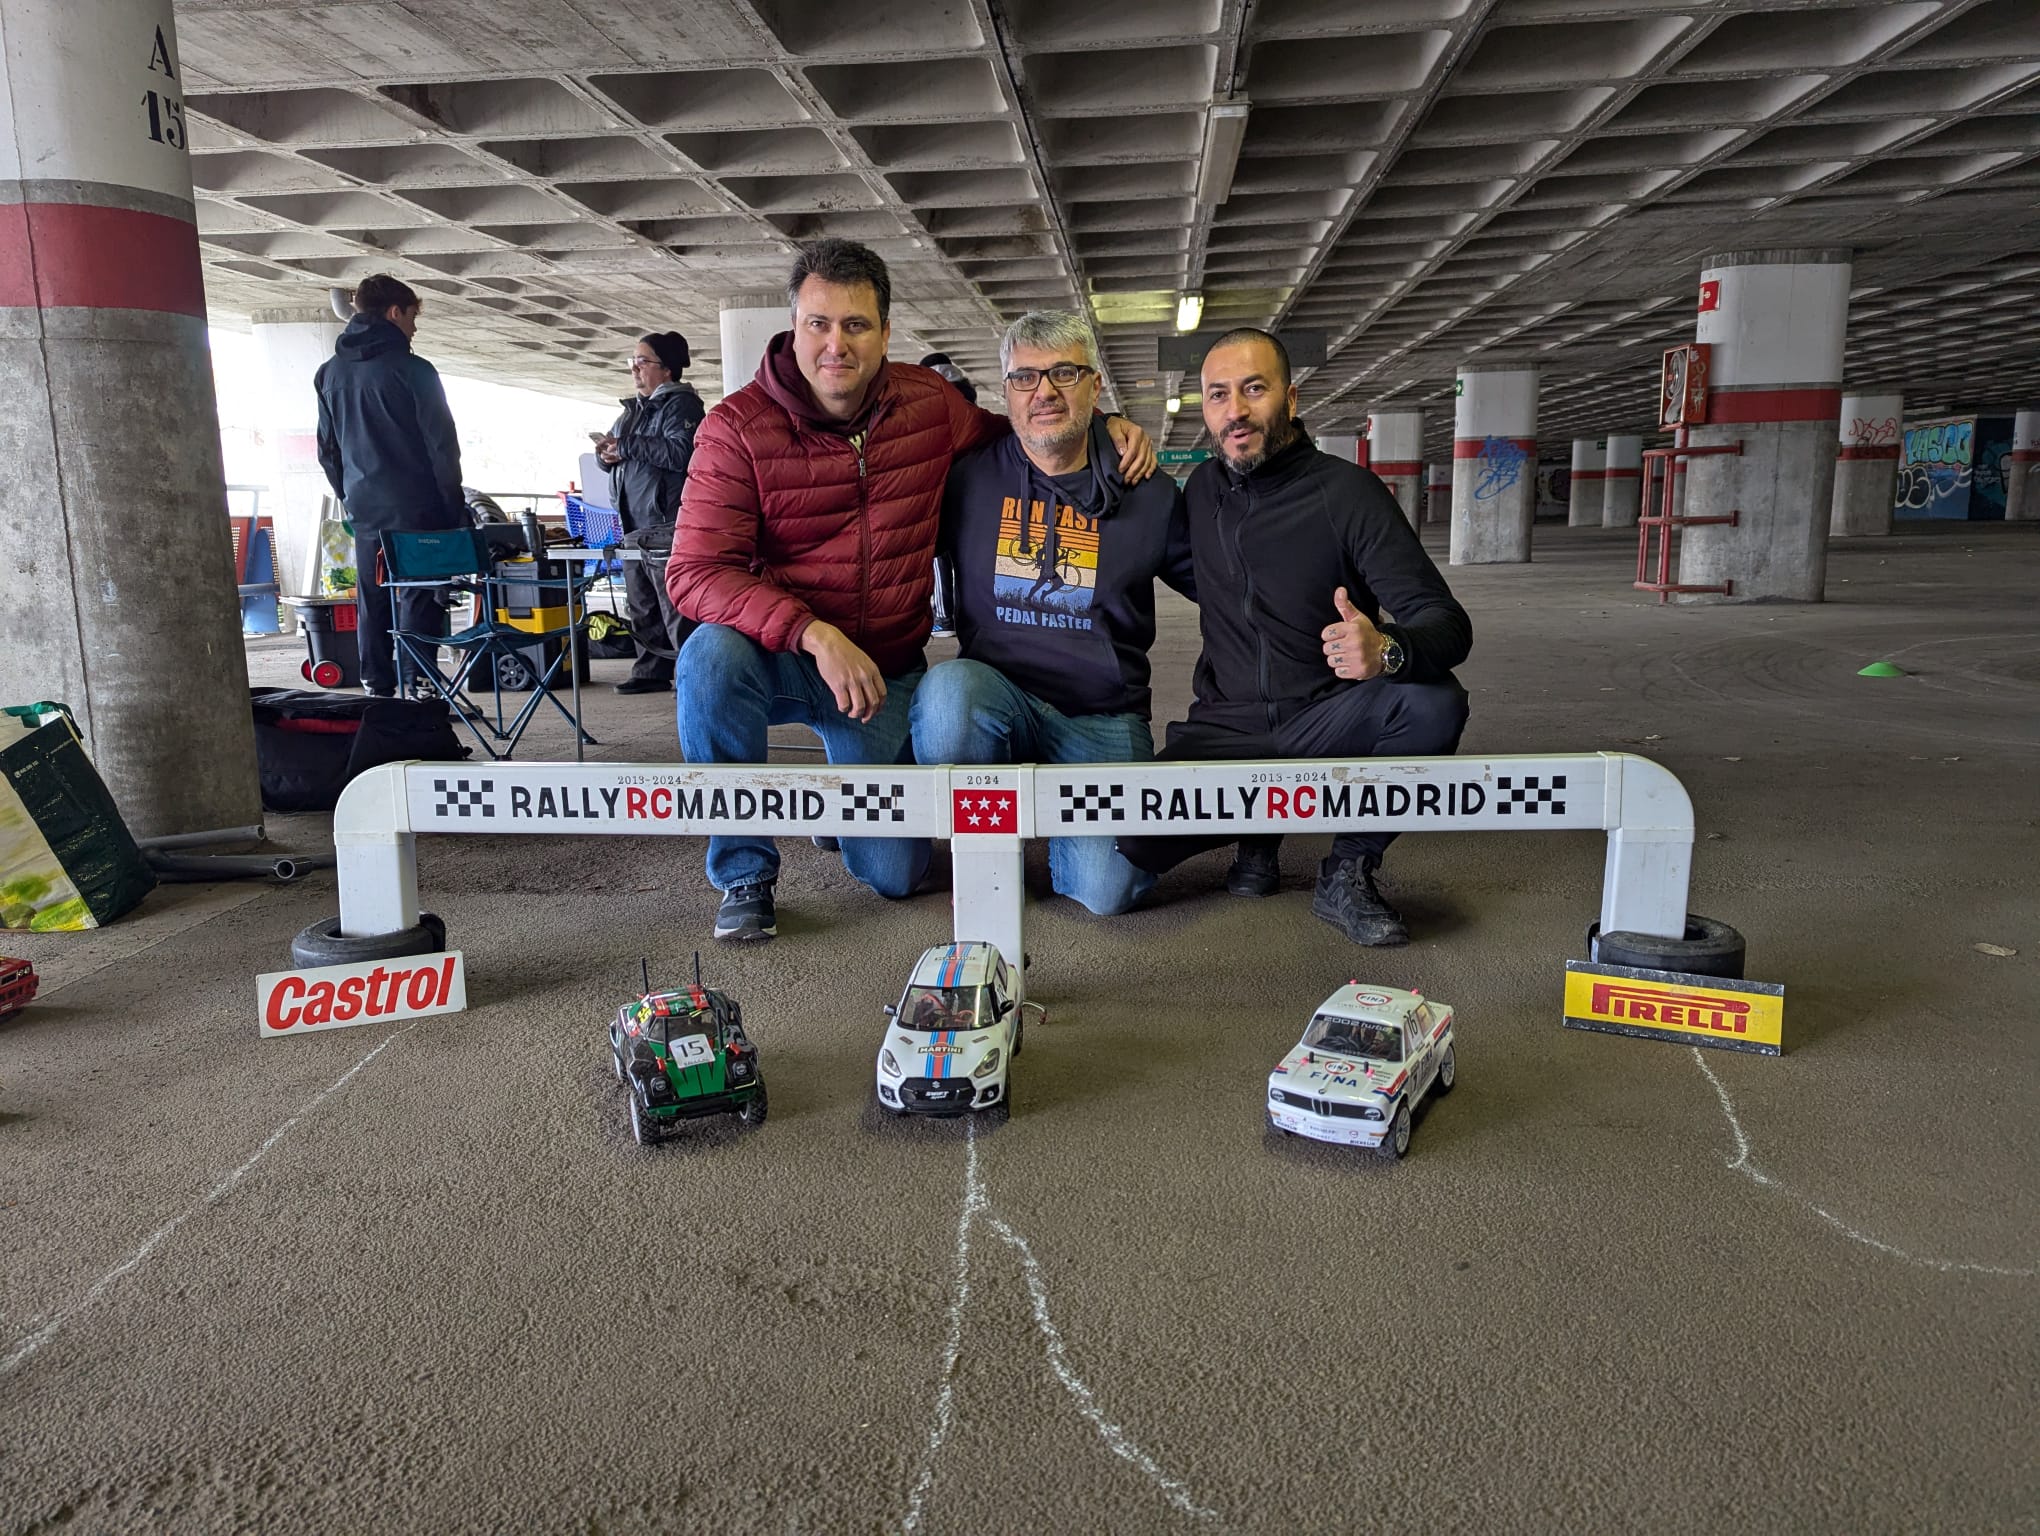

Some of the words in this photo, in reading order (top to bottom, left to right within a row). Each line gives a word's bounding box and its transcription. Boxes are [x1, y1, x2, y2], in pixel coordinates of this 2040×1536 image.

[147, 24, 175, 80] A
[141, 90, 185, 150] 15
[996, 606, 1037, 626] PEDAL
[1041, 613, 1092, 630] FASTER
[618, 775, 682, 785] 2013-2024
[967, 775, 1000, 785] 2024
[1251, 771, 1327, 783] 2013-2024
[511, 785, 825, 820] RALLYRCMADRID
[1141, 783, 1486, 820] RALLYRCMADRID
[266, 957, 456, 1030] Castrol
[1360, 993, 1385, 1003] FINA
[1592, 983, 1751, 1033] PIRELLI
[1323, 1016, 1359, 1026] 2002
[676, 1040, 705, 1057] 15
[1327, 1063, 1349, 1072] FINA
[1310, 1071, 1357, 1087] FINA
